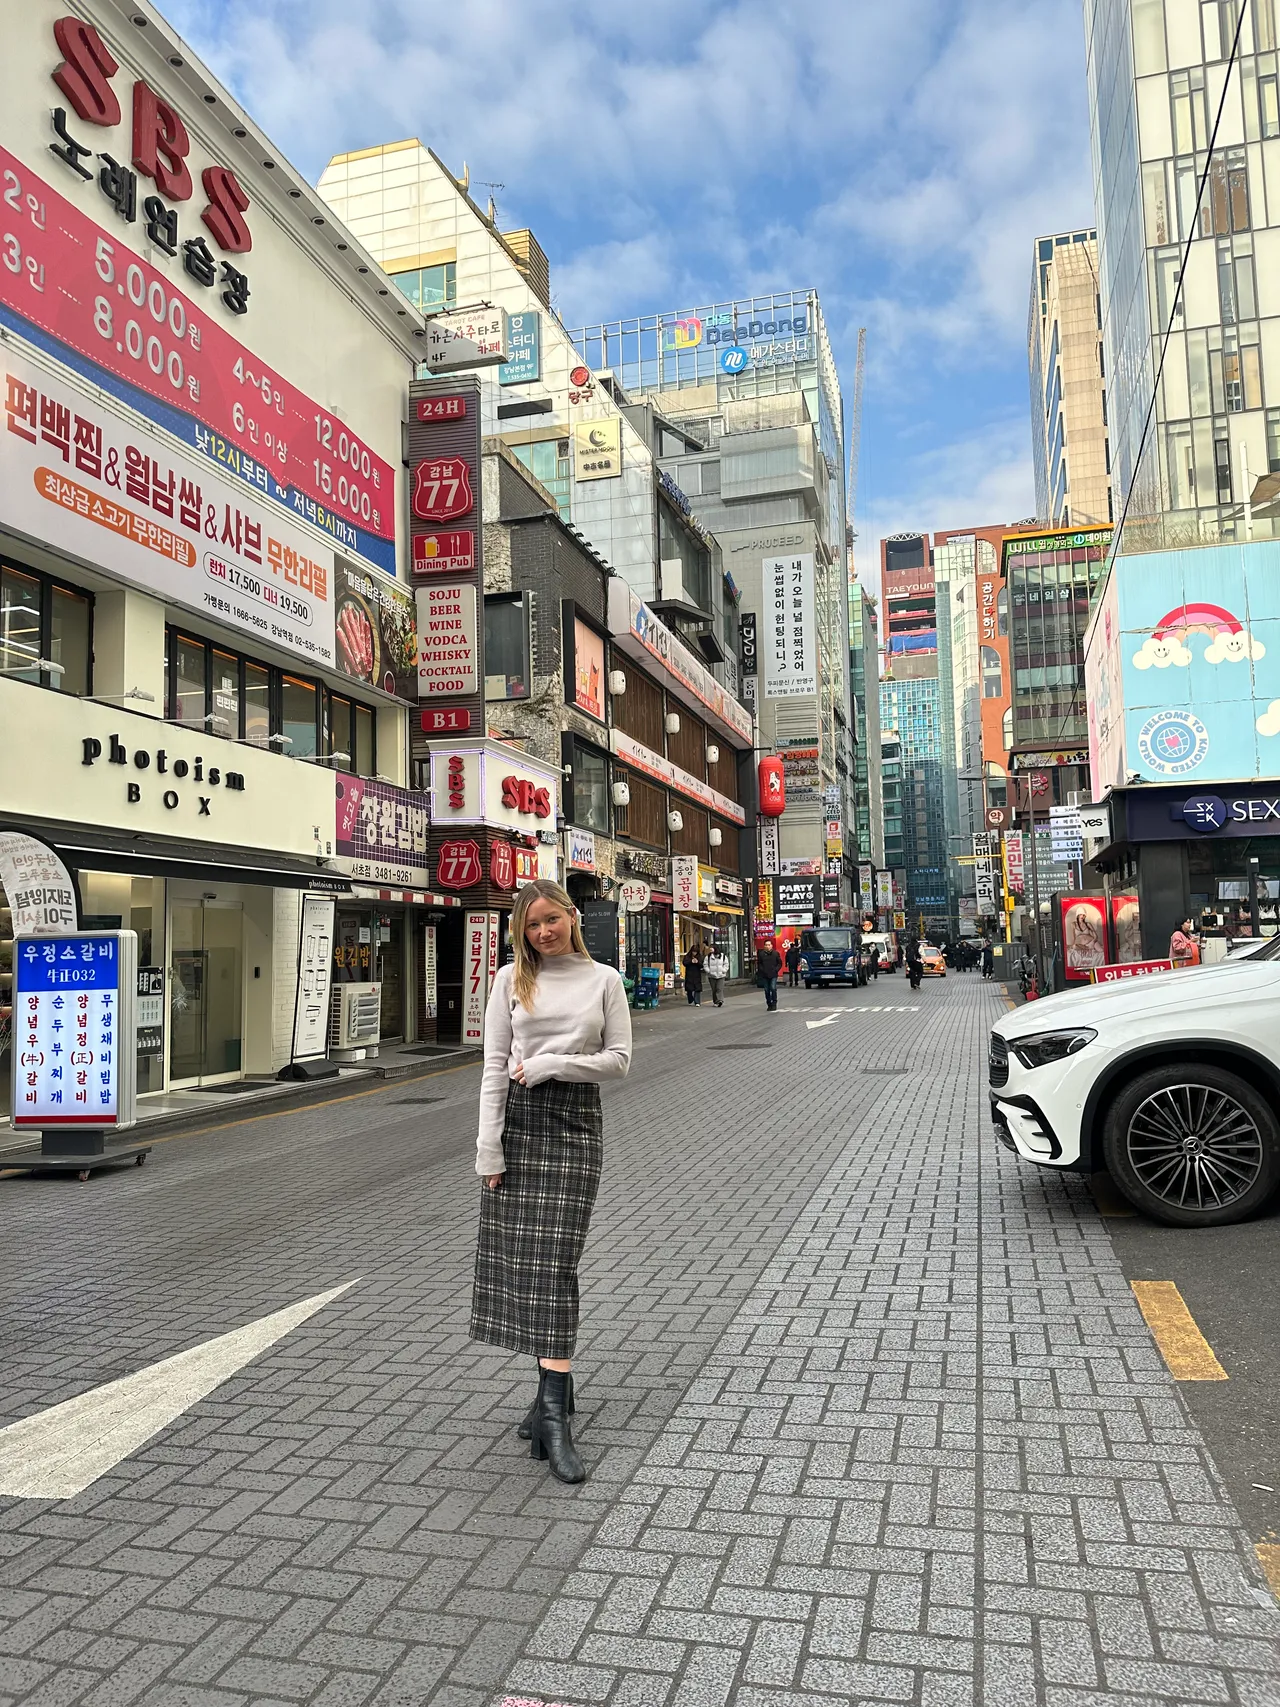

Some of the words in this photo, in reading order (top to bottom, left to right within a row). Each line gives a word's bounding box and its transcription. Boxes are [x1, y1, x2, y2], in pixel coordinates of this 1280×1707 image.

[52, 15, 252, 252] SBS
[2, 168, 46, 229] 2인
[48, 106, 251, 314] 노래연습장
[2, 232, 46, 292] 3인
[468, 314, 486, 322] CAFE
[706, 313, 731, 327] 대동
[706, 316, 807, 345] DaeDong
[432, 352, 446, 362] 4F
[477, 339, 501, 354] 카페
[751, 339, 808, 359] 메가스터디
[232, 357, 286, 416] 4~5인
[422, 399, 460, 417] 24H
[569, 390, 593, 405] 당구
[232, 402, 260, 444] 6인
[264, 431, 288, 465] 이상
[430, 465, 454, 479] 강남
[423, 478, 460, 509] 77
[45, 474, 90, 515] 최상급
[91, 500, 131, 536] 소고기
[132, 516, 191, 566] 무한리필
[752, 535, 804, 549] PROCEED
[266, 536, 329, 602] 무한리필
[416, 558, 448, 570] Dining
[450, 557, 469, 568] Pub
[791, 560, 803, 583] 내가
[209, 557, 226, 580] 런치
[228, 568, 261, 597] 17,500
[263, 586, 279, 606] 디너
[280, 594, 308, 621] 19,500
[429, 589, 462, 601] SOJU
[773, 563, 785, 610] 눈썹없이
[886, 582, 936, 594] TAEYOUN
[1029, 589, 1070, 601] 네일샵
[792, 586, 803, 609] 오늘
[203, 593, 231, 615] 가맹문의
[271, 624, 294, 643] 강남역점
[429, 604, 462, 616] BEER
[793, 611, 803, 623] 널
[429, 619, 462, 632] WINE
[424, 634, 468, 647] VODCA
[774, 613, 787, 673] 헌팅되니?
[421, 649, 472, 663] WHISKY
[419, 665, 474, 678] COCKTAIL
[429, 679, 464, 693] FOOD
[433, 712, 459, 729] B1
[1140, 711, 1191, 736] WELCOME
[1192, 719, 1205, 733] TO
[82, 734, 246, 791] photoism
[1139, 739, 1166, 772] WORLD
[1170, 738, 1208, 773] KNOTTED
[448, 755, 465, 810] SBS
[502, 775, 551, 819] SBS
[361, 796, 429, 854] 장원김밥
[990, 812, 1001, 821] 약
[450, 847, 468, 857] 강남
[351, 863, 371, 878] 서초점
[375, 866, 413, 883] 3481-9261
[445, 857, 472, 880] 77
[498, 858, 510, 880] 77
[675, 865, 694, 876] 중앙
[309, 879, 333, 889] photoism
[622, 886, 647, 901] 막창
[677, 877, 692, 908] 곱창
[779, 884, 814, 893] PARTY
[779, 892, 806, 901] PLAY
[23, 941, 114, 964] 우정소갈비
[47, 968, 96, 984] 牛正032
[20, 995, 45, 1105] 양념우(牛)갈비
[50, 995, 65, 1105] 순두부찌개
[70, 995, 94, 1105] 양념정(正)갈비
[99, 994, 114, 1105] 무생채비빔밥
